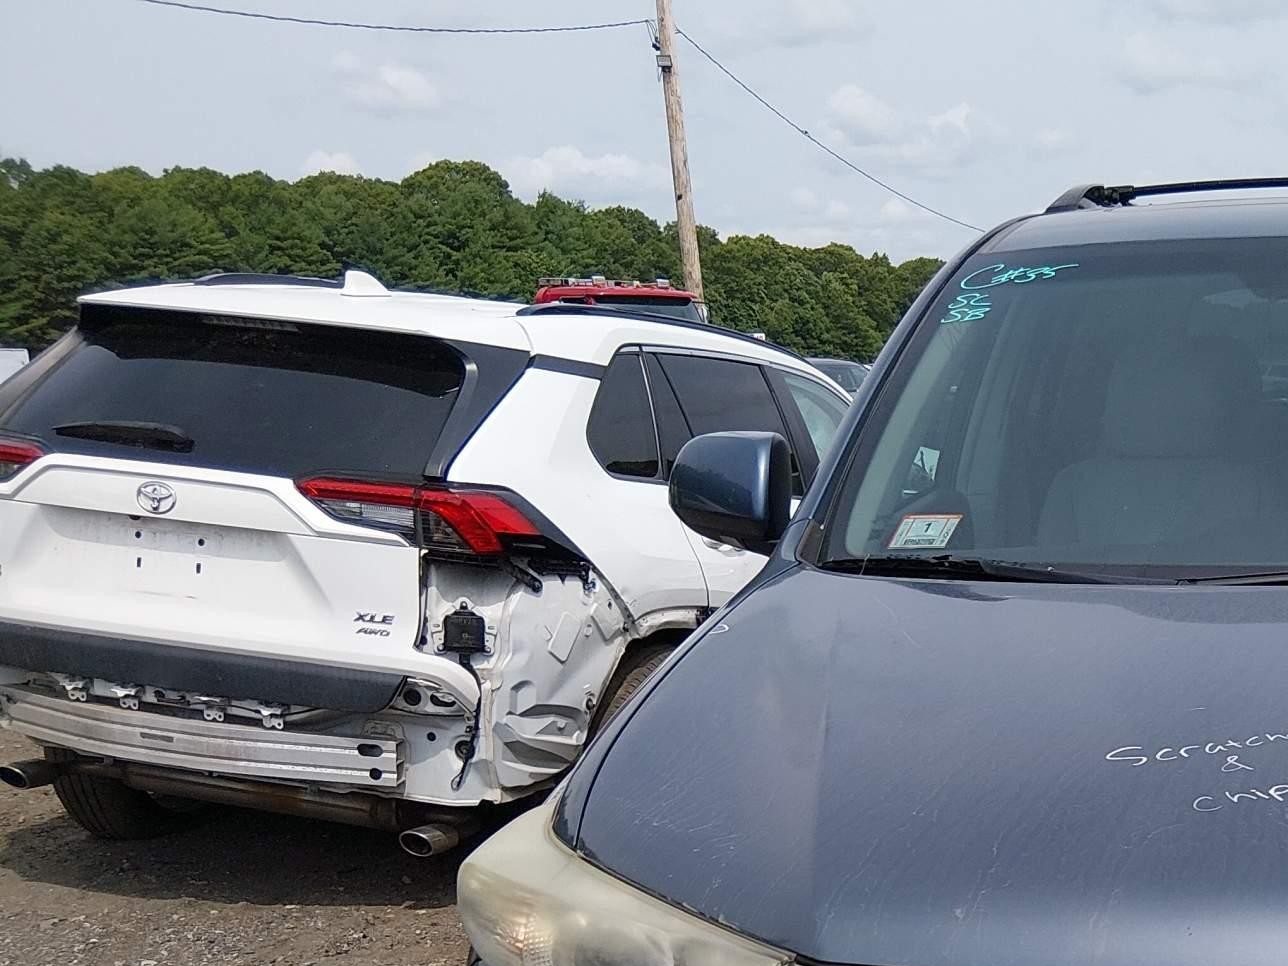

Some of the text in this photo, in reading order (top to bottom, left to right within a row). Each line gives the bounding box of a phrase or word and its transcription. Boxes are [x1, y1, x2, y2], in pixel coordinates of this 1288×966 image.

[923, 522, 933, 534] 1
[353, 611, 395, 625] XLE
[355, 627, 391, 637] AWD
[1221, 755, 1254, 772] &
